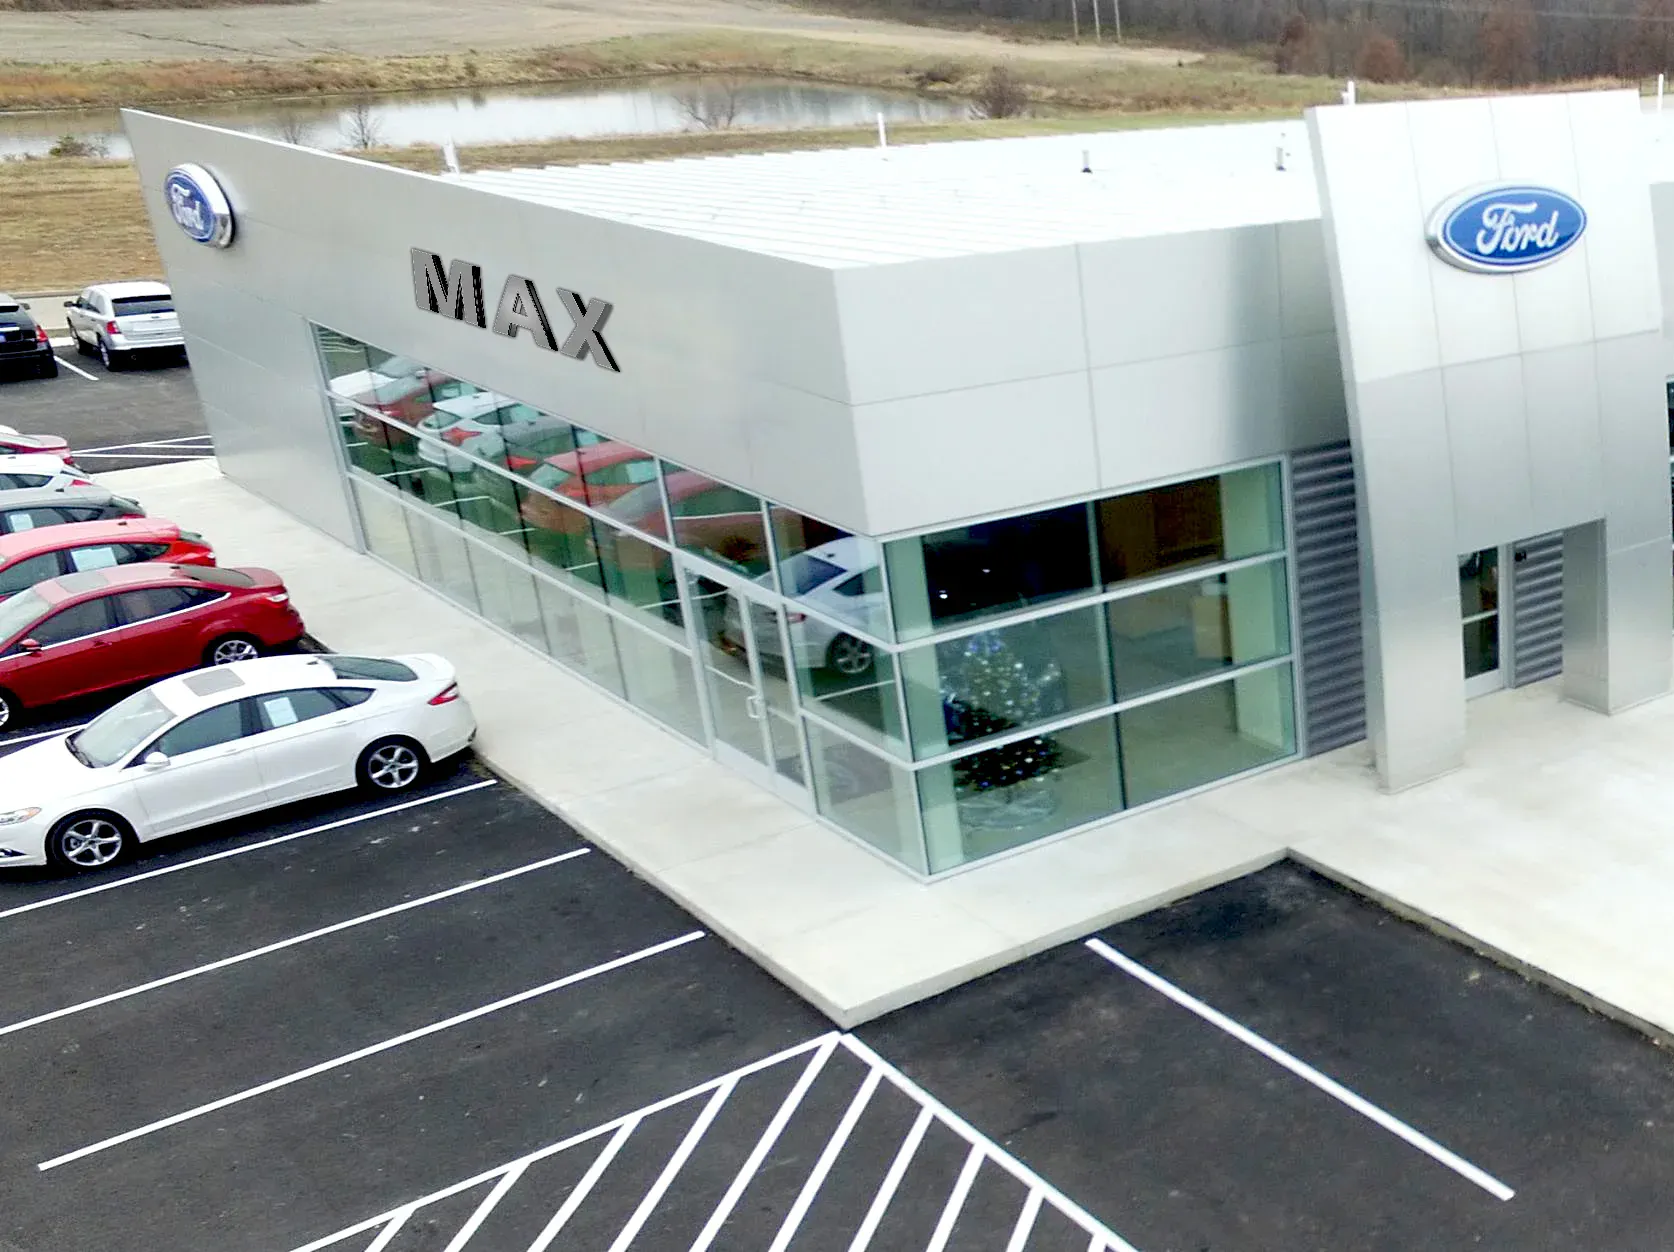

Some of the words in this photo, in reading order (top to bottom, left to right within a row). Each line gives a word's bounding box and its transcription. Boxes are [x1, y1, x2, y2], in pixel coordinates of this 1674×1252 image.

[171, 183, 205, 231] Ford
[1476, 201, 1560, 255] Ford
[410, 247, 621, 373] MAX
